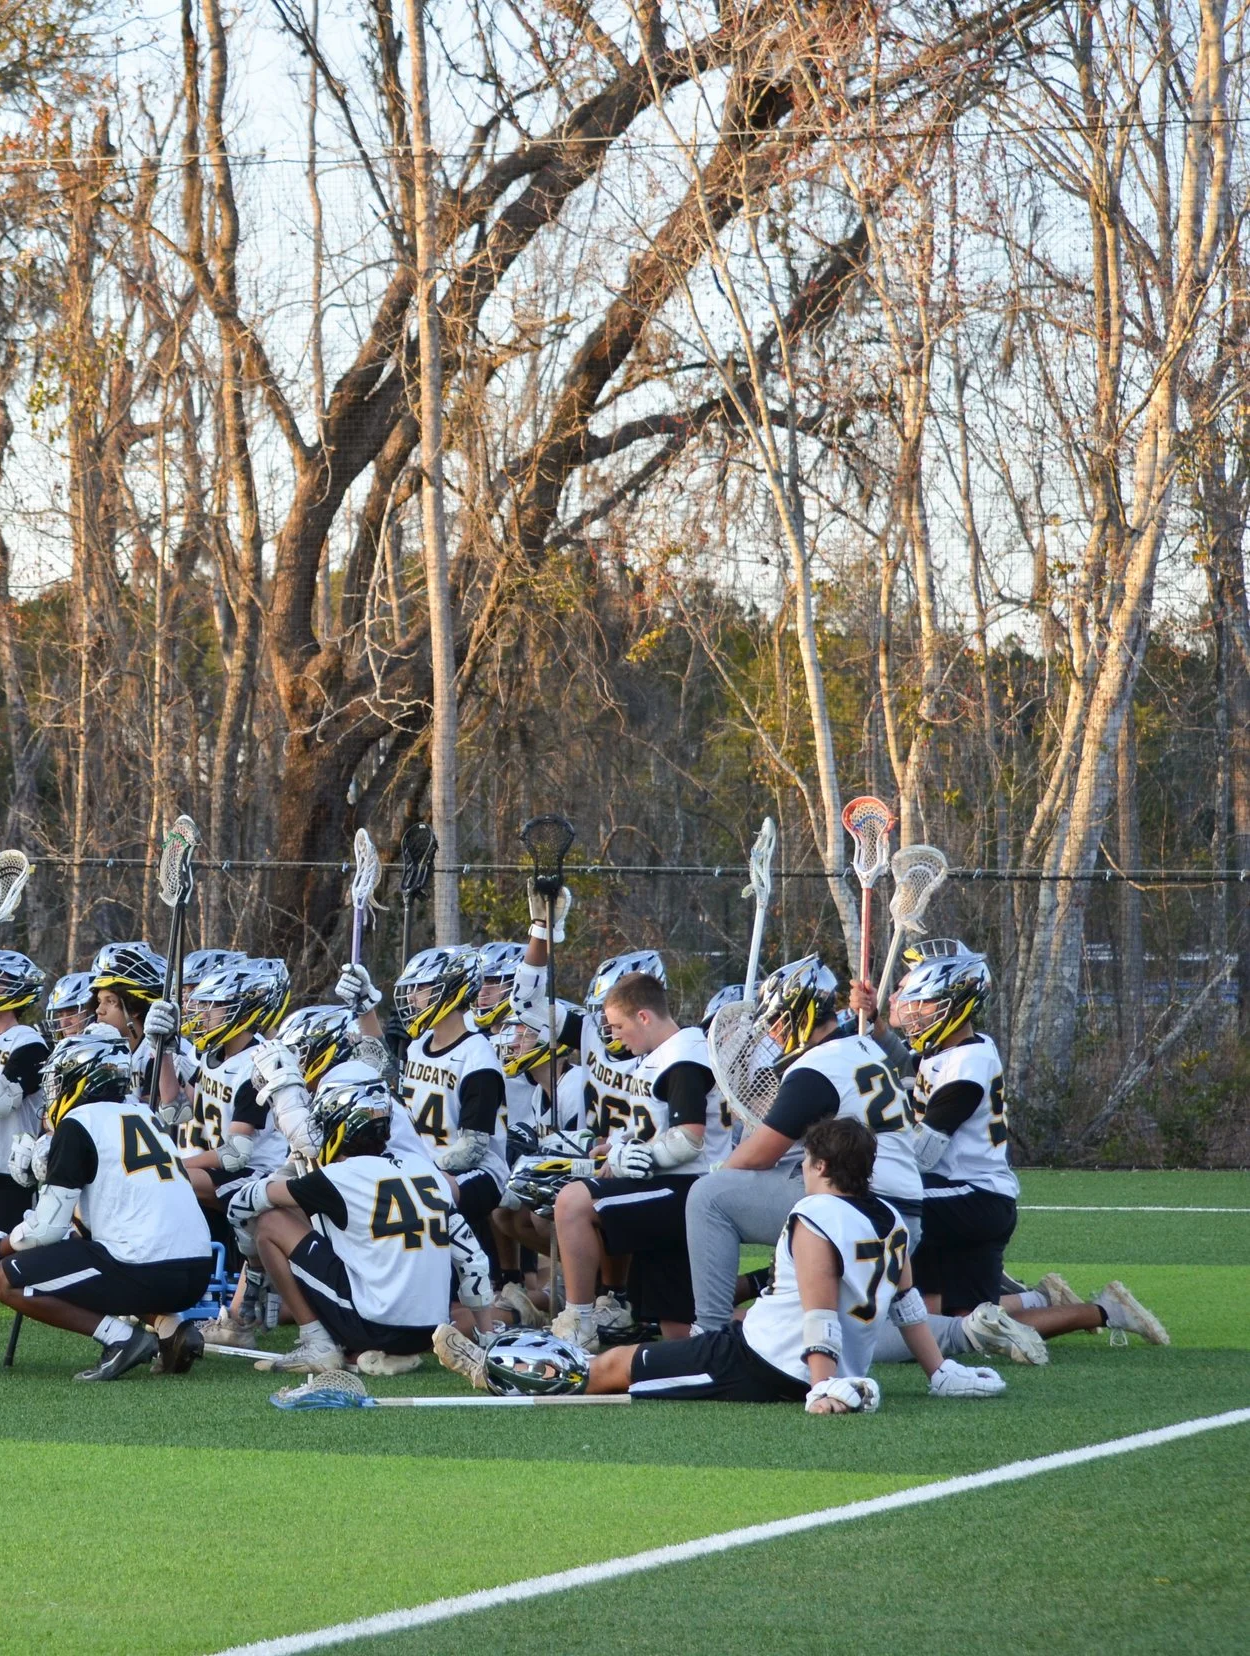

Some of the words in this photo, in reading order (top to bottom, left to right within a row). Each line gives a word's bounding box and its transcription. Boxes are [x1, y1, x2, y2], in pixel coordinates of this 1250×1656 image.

[405, 1061, 458, 1091] ILDCATS
[854, 1062, 915, 1134] 2
[120, 1112, 192, 1184] 4
[402, 1086, 449, 1147] 4
[369, 1173, 450, 1252] 45
